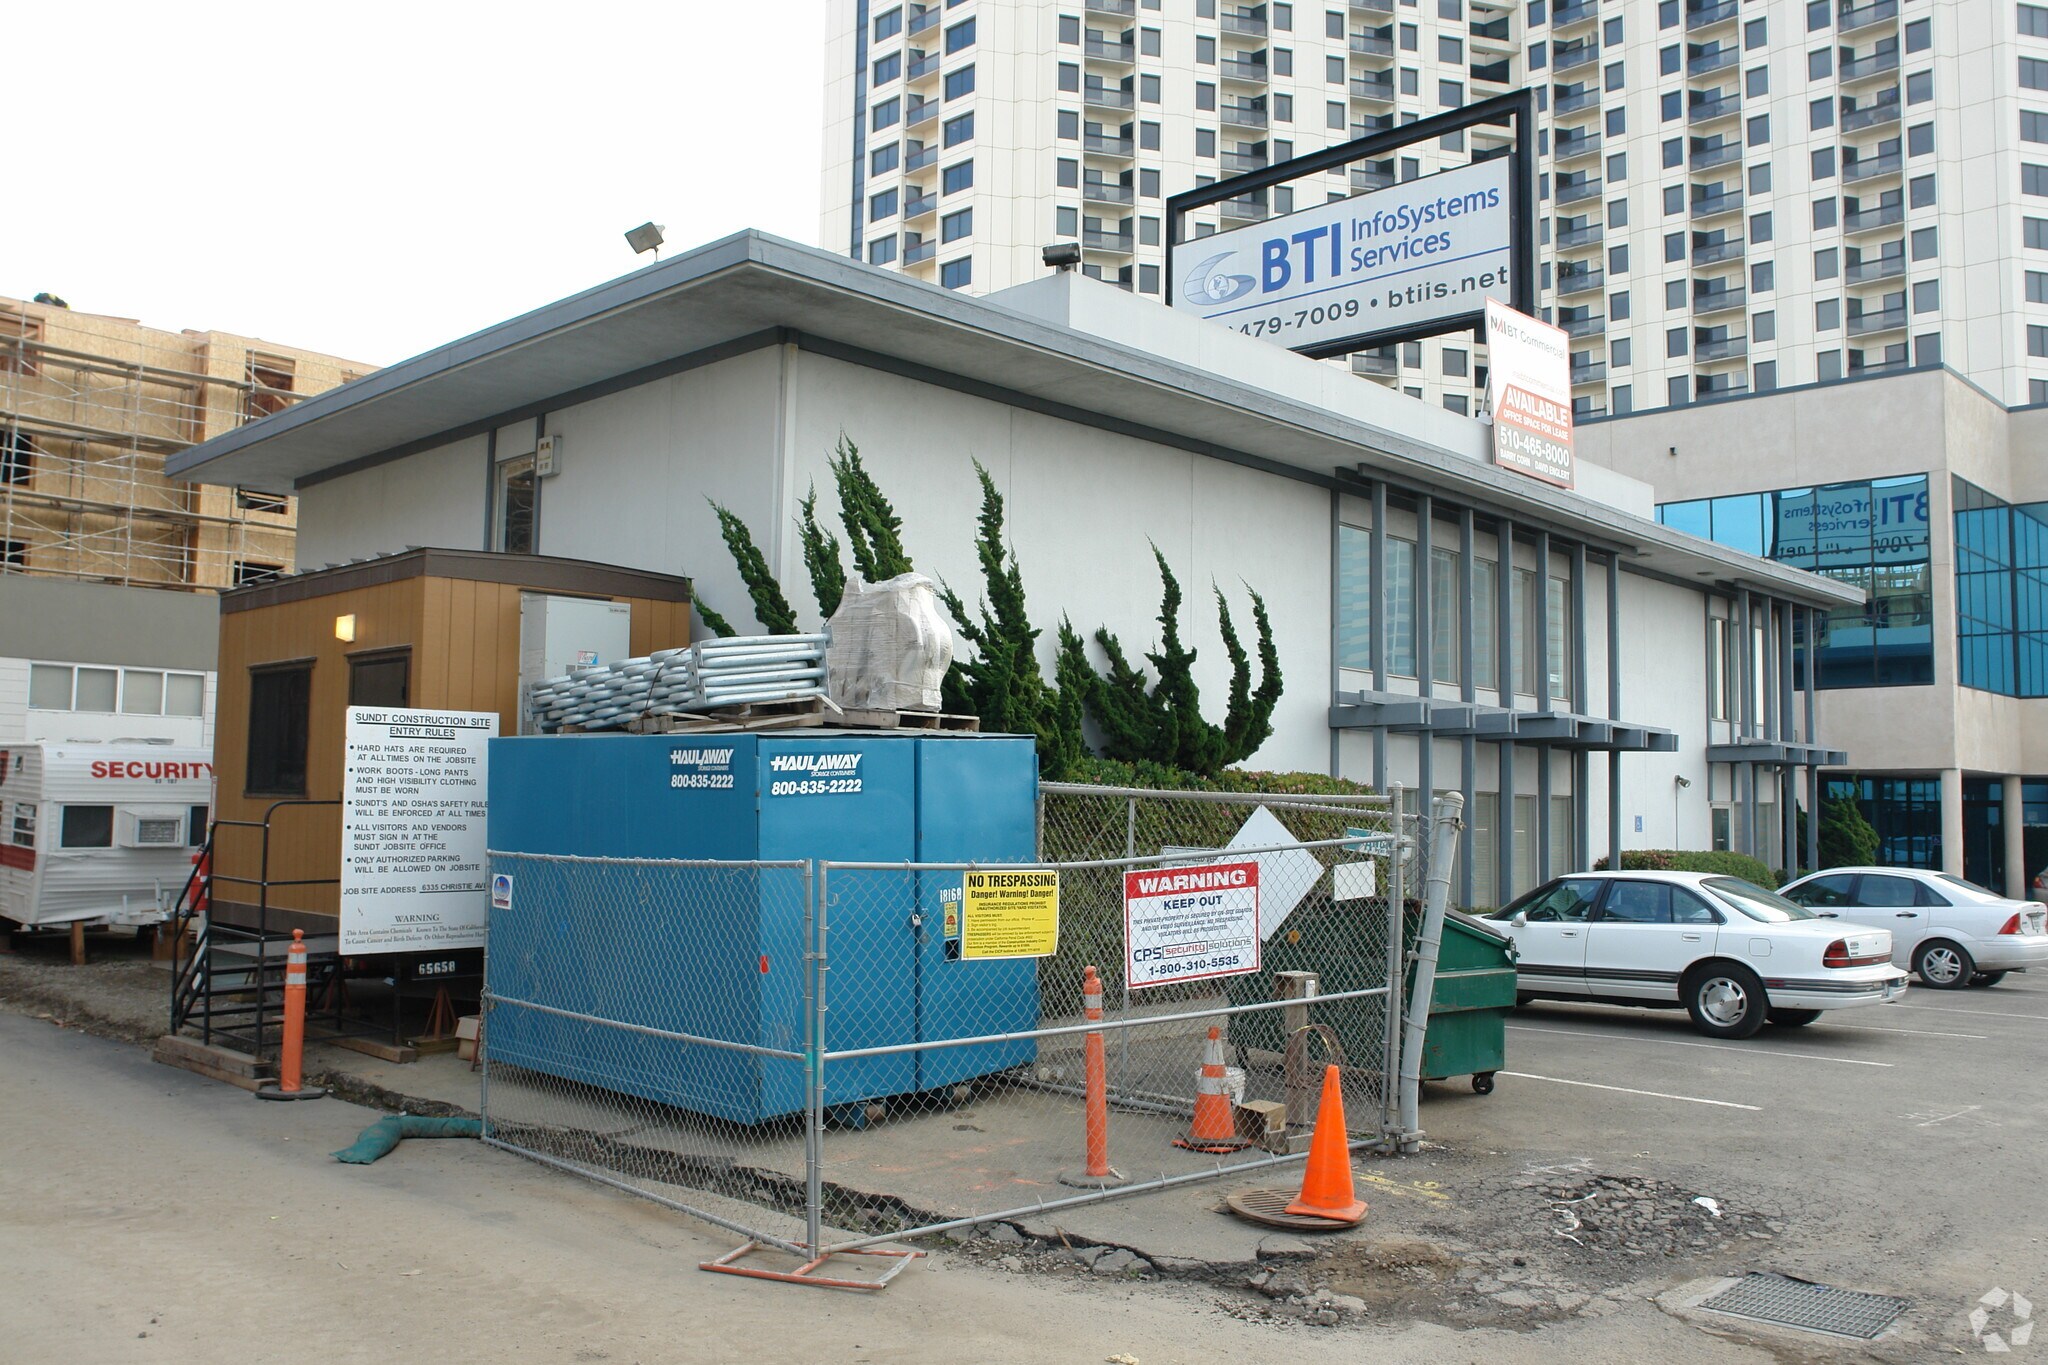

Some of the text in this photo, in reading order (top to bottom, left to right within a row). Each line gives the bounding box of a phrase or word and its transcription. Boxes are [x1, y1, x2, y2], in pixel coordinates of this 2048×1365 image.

[1351, 188, 1499, 242] InfoSystems
[1262, 222, 1341, 294] BTI
[1351, 231, 1450, 272] Services
[1388, 266, 1507, 308] btiis.net
[1520, 330, 1565, 359] Commercial
[1505, 386, 1569, 428] AVAILABLE
[1503, 408, 1569, 441] OFFICE SPACE FOR LEASE
[1500, 425, 1570, 467] 510-465-8000
[355, 713, 491, 726] SUNDT CONSTRUCTION SITE
[389, 727, 455, 737] ENTRY RULES
[384, 745, 405, 753] HATS
[413, 755, 424, 763] ON
[670, 748, 734, 765] HAULAWAY
[770, 753, 862, 772] HAULAWAY
[91, 761, 213, 779] SECURITY
[386, 767, 413, 775] BOOTS
[420, 768, 441, 776] LONG
[444, 769, 469, 777] PANTS
[399, 777, 438, 785] VISIBILITY
[440, 778, 477, 786] CLOTHING
[671, 774, 734, 788] 800-835-2222
[771, 779, 862, 795] 800-835-2222
[355, 786, 378, 794] MUST
[381, 786, 391, 794] BE
[355, 799, 388, 807] SUNDT'S
[440, 800, 468, 808] SAFETY
[372, 823, 408, 831] VISITORS
[354, 856, 375, 864] ONLY
[968, 874, 1056, 888] NO TRESPASSING
[1138, 869, 1246, 894] WARNING
[380, 886, 417, 894] ADDRESS
[971, 889, 1054, 899] Danger! Warning! Danger!
[1163, 895, 1223, 910] KEEP OUT
[394, 914, 440, 923] WARNING
[1133, 939, 1251, 962] CPS security solutions
[419, 961, 456, 974] 65658
[1149, 955, 1239, 976] 1-800-310-5535
